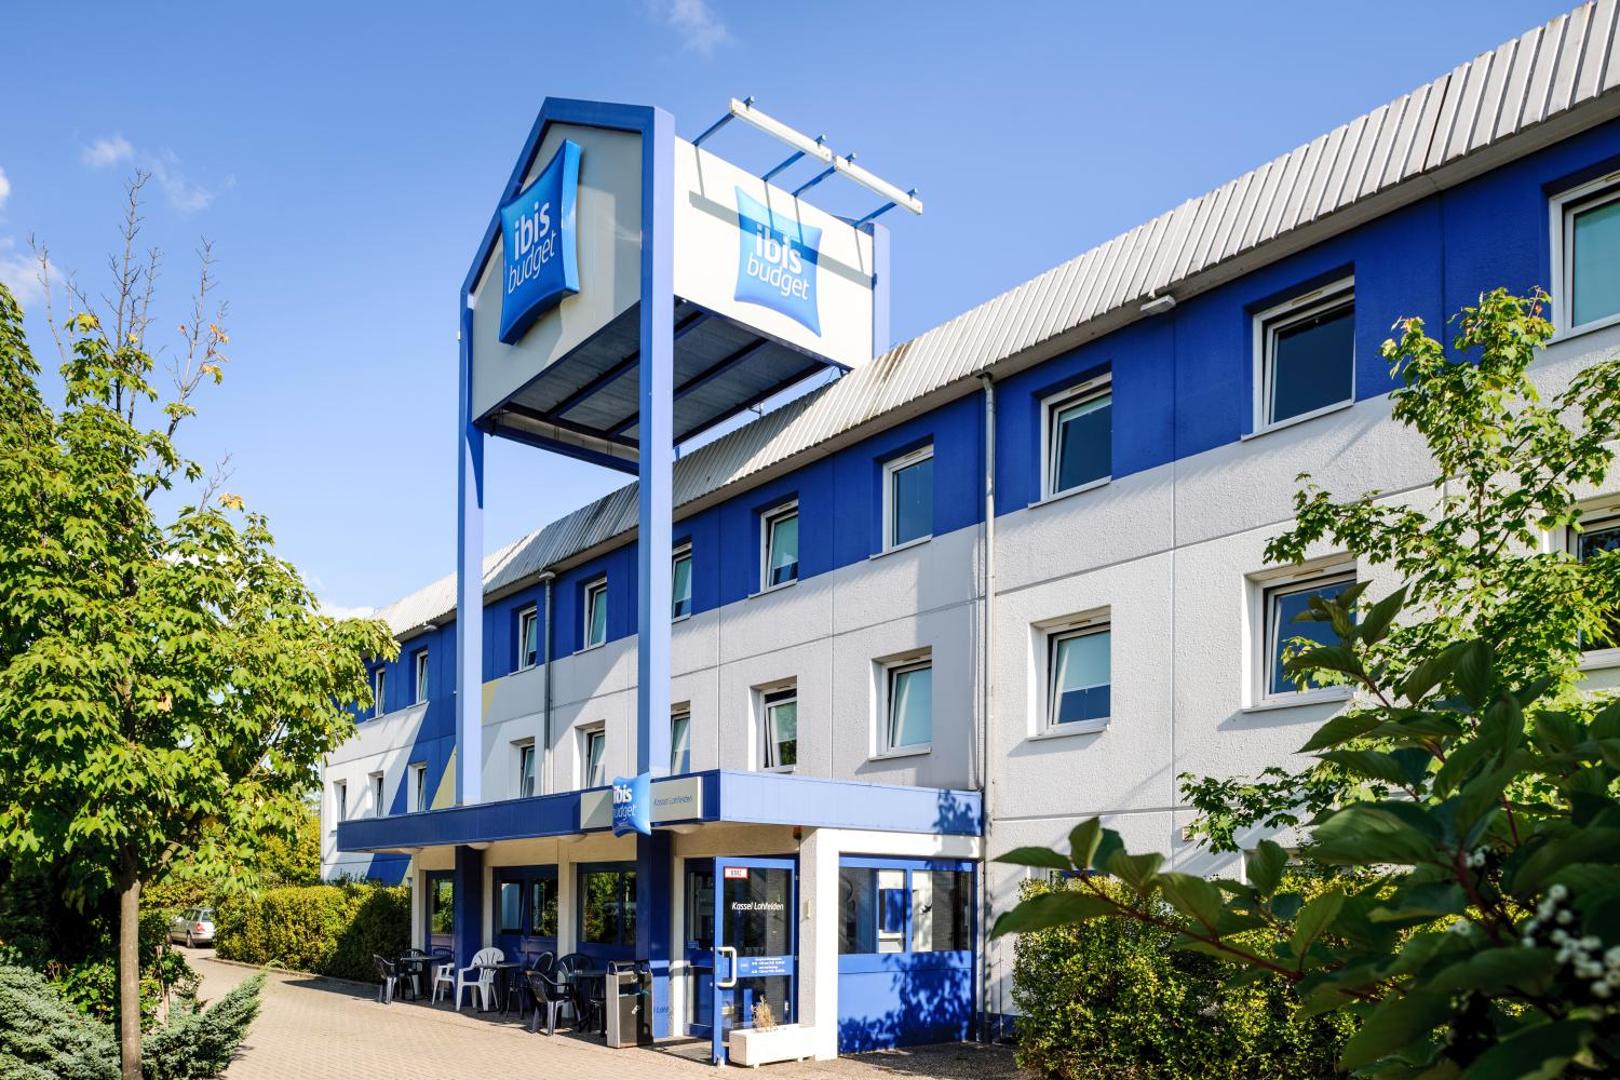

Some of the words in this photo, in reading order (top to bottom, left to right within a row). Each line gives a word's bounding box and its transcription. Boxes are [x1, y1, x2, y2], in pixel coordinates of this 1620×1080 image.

[514, 201, 550, 261] ibis
[756, 223, 802, 274] ibis
[508, 229, 556, 294] budget
[747, 251, 810, 300] budget
[732, 901, 753, 911] Kassel
